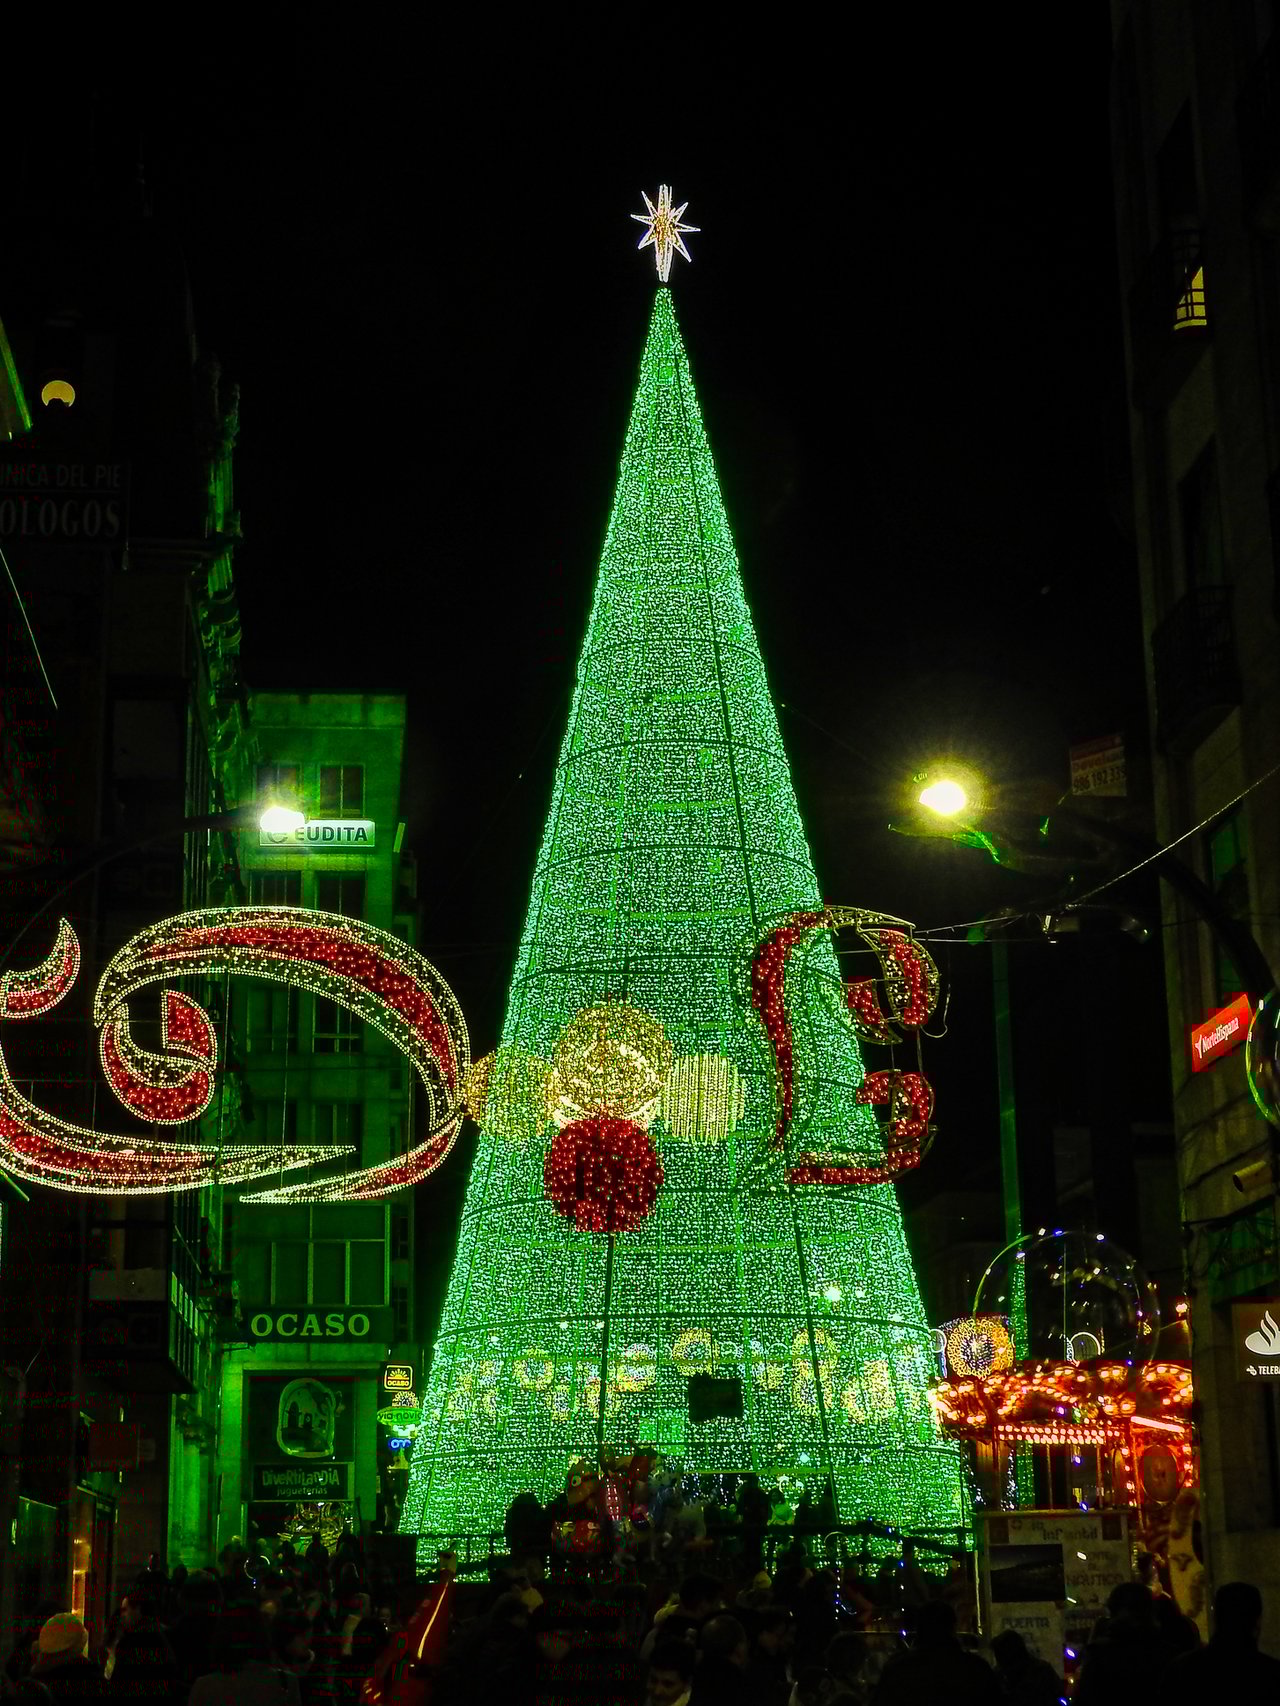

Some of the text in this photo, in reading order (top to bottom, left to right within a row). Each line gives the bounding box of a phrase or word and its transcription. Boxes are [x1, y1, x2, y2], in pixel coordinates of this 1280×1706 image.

[56, 463, 88, 488] DEL
[95, 464, 121, 488] PIE
[0, 498, 121, 538] OLOGOS
[250, 1313, 370, 1337] OCASO
